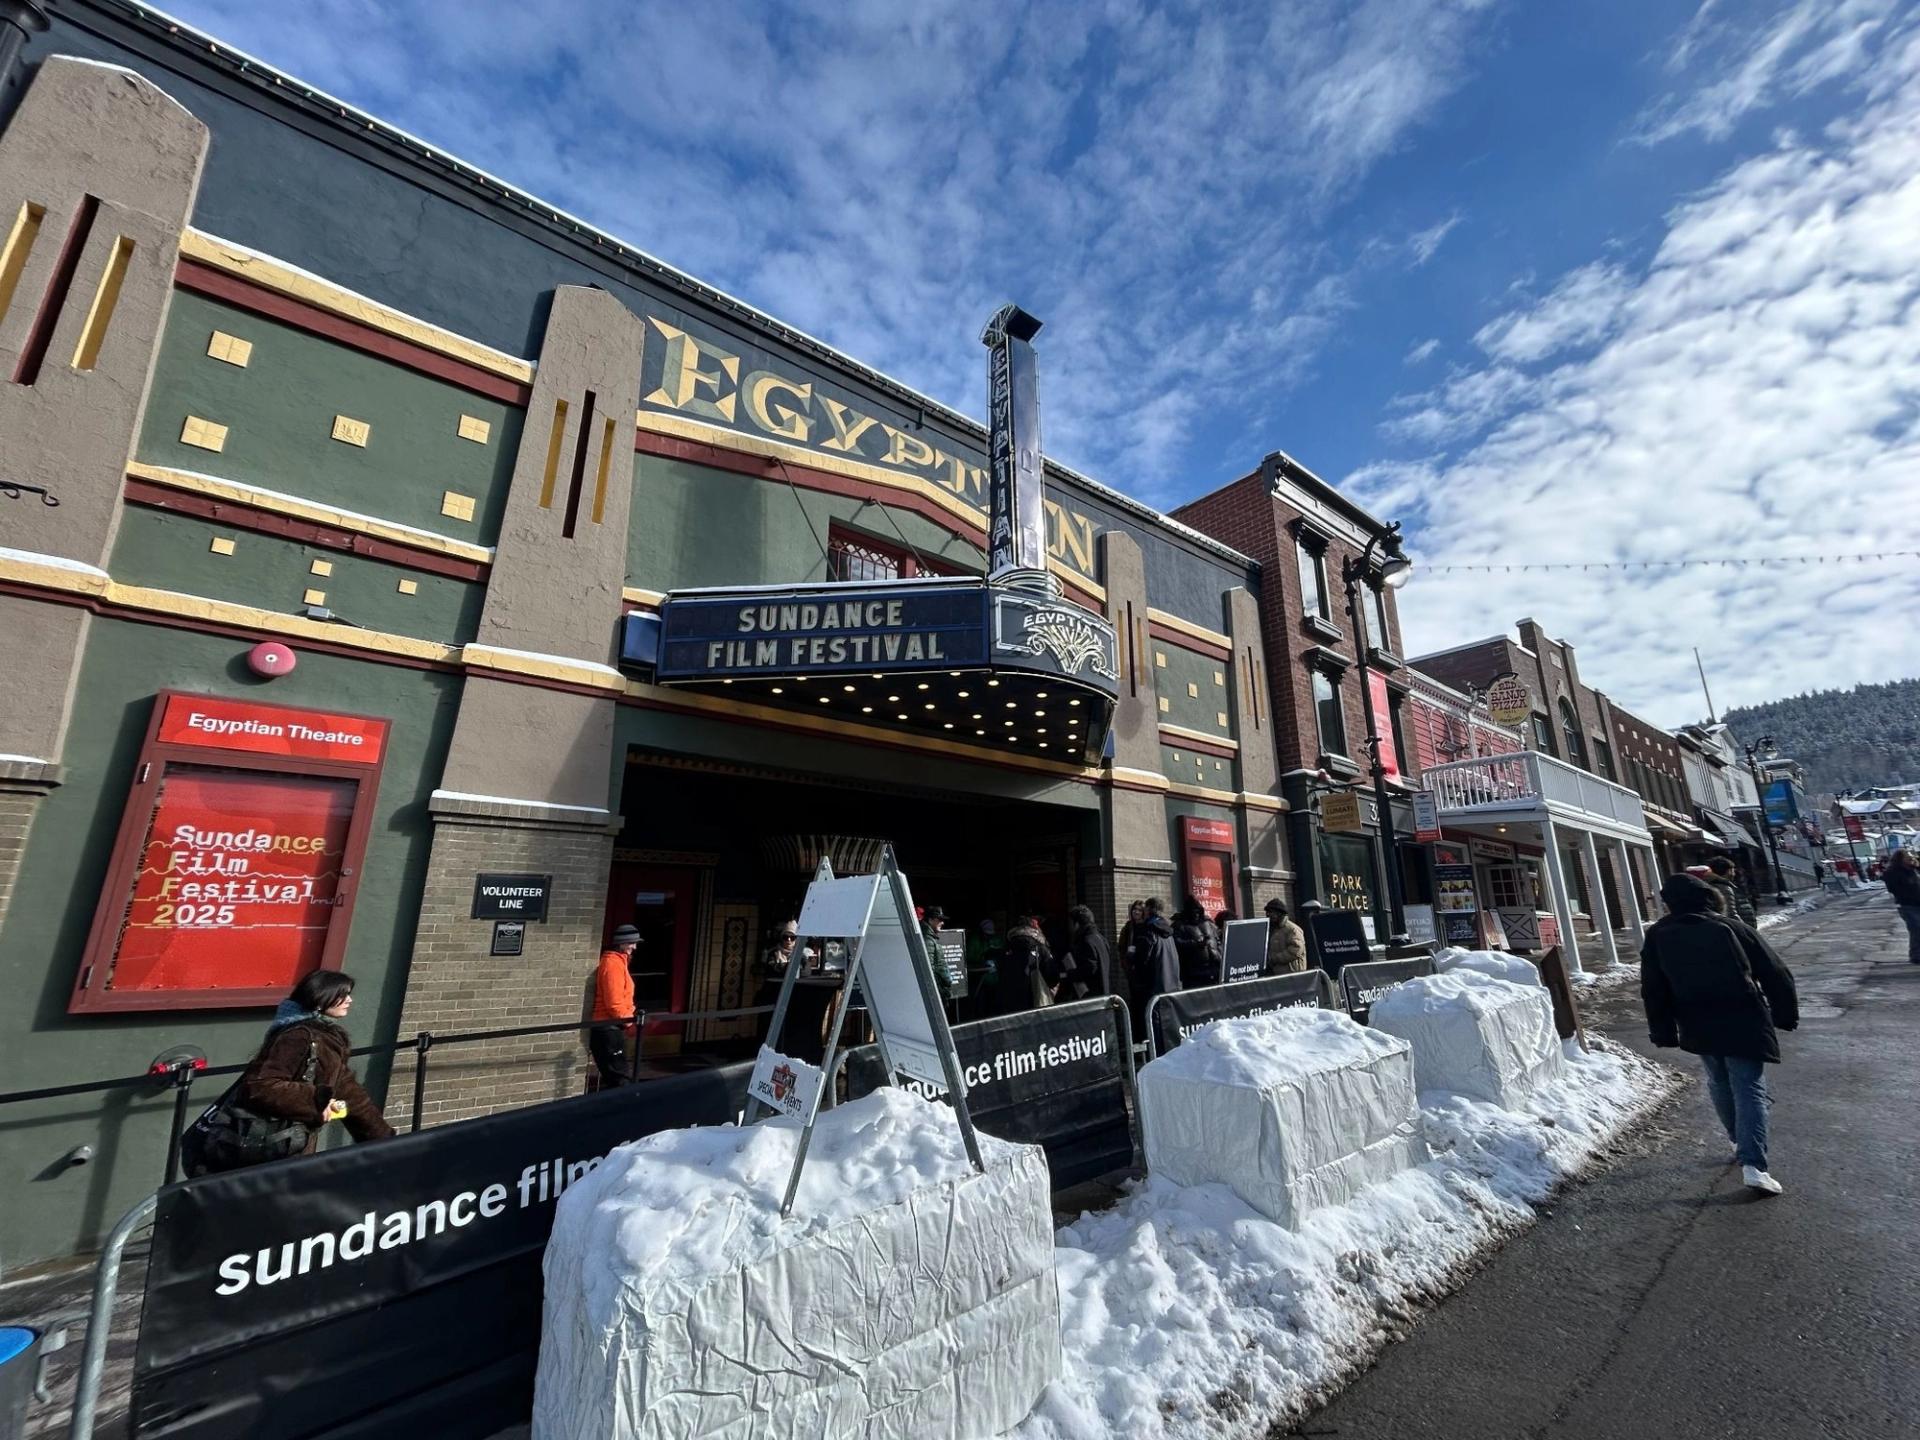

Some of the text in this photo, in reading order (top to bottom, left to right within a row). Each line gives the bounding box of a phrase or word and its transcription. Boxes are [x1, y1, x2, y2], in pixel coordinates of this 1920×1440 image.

[643, 315, 1101, 578] EGYPTN
[992, 345, 1013, 573] EGYPTIAN
[738, 599, 904, 633] SUNDANCE
[1023, 611, 1104, 648] EGYPTIAN
[706, 632, 945, 669] FILM FESTIVAL
[1490, 688, 1527, 702] BANJO
[1491, 698, 1528, 712] PIZZA
[187, 712, 364, 746] Egyptian Theatre
[173, 825, 327, 852] Sundance
[167, 851, 249, 873] Film
[160, 877, 314, 901] Festival
[482, 886, 543, 897] VOLUNTEER
[1332, 873, 1362, 892] PARK
[498, 899, 524, 909] LINE
[1330, 893, 1369, 910] PLACE
[152, 904, 236, 925] 2025
[993, 1050, 1037, 1081] film
[1037, 1030, 1108, 1069] festival
[214, 1182, 507, 1296] sundance
